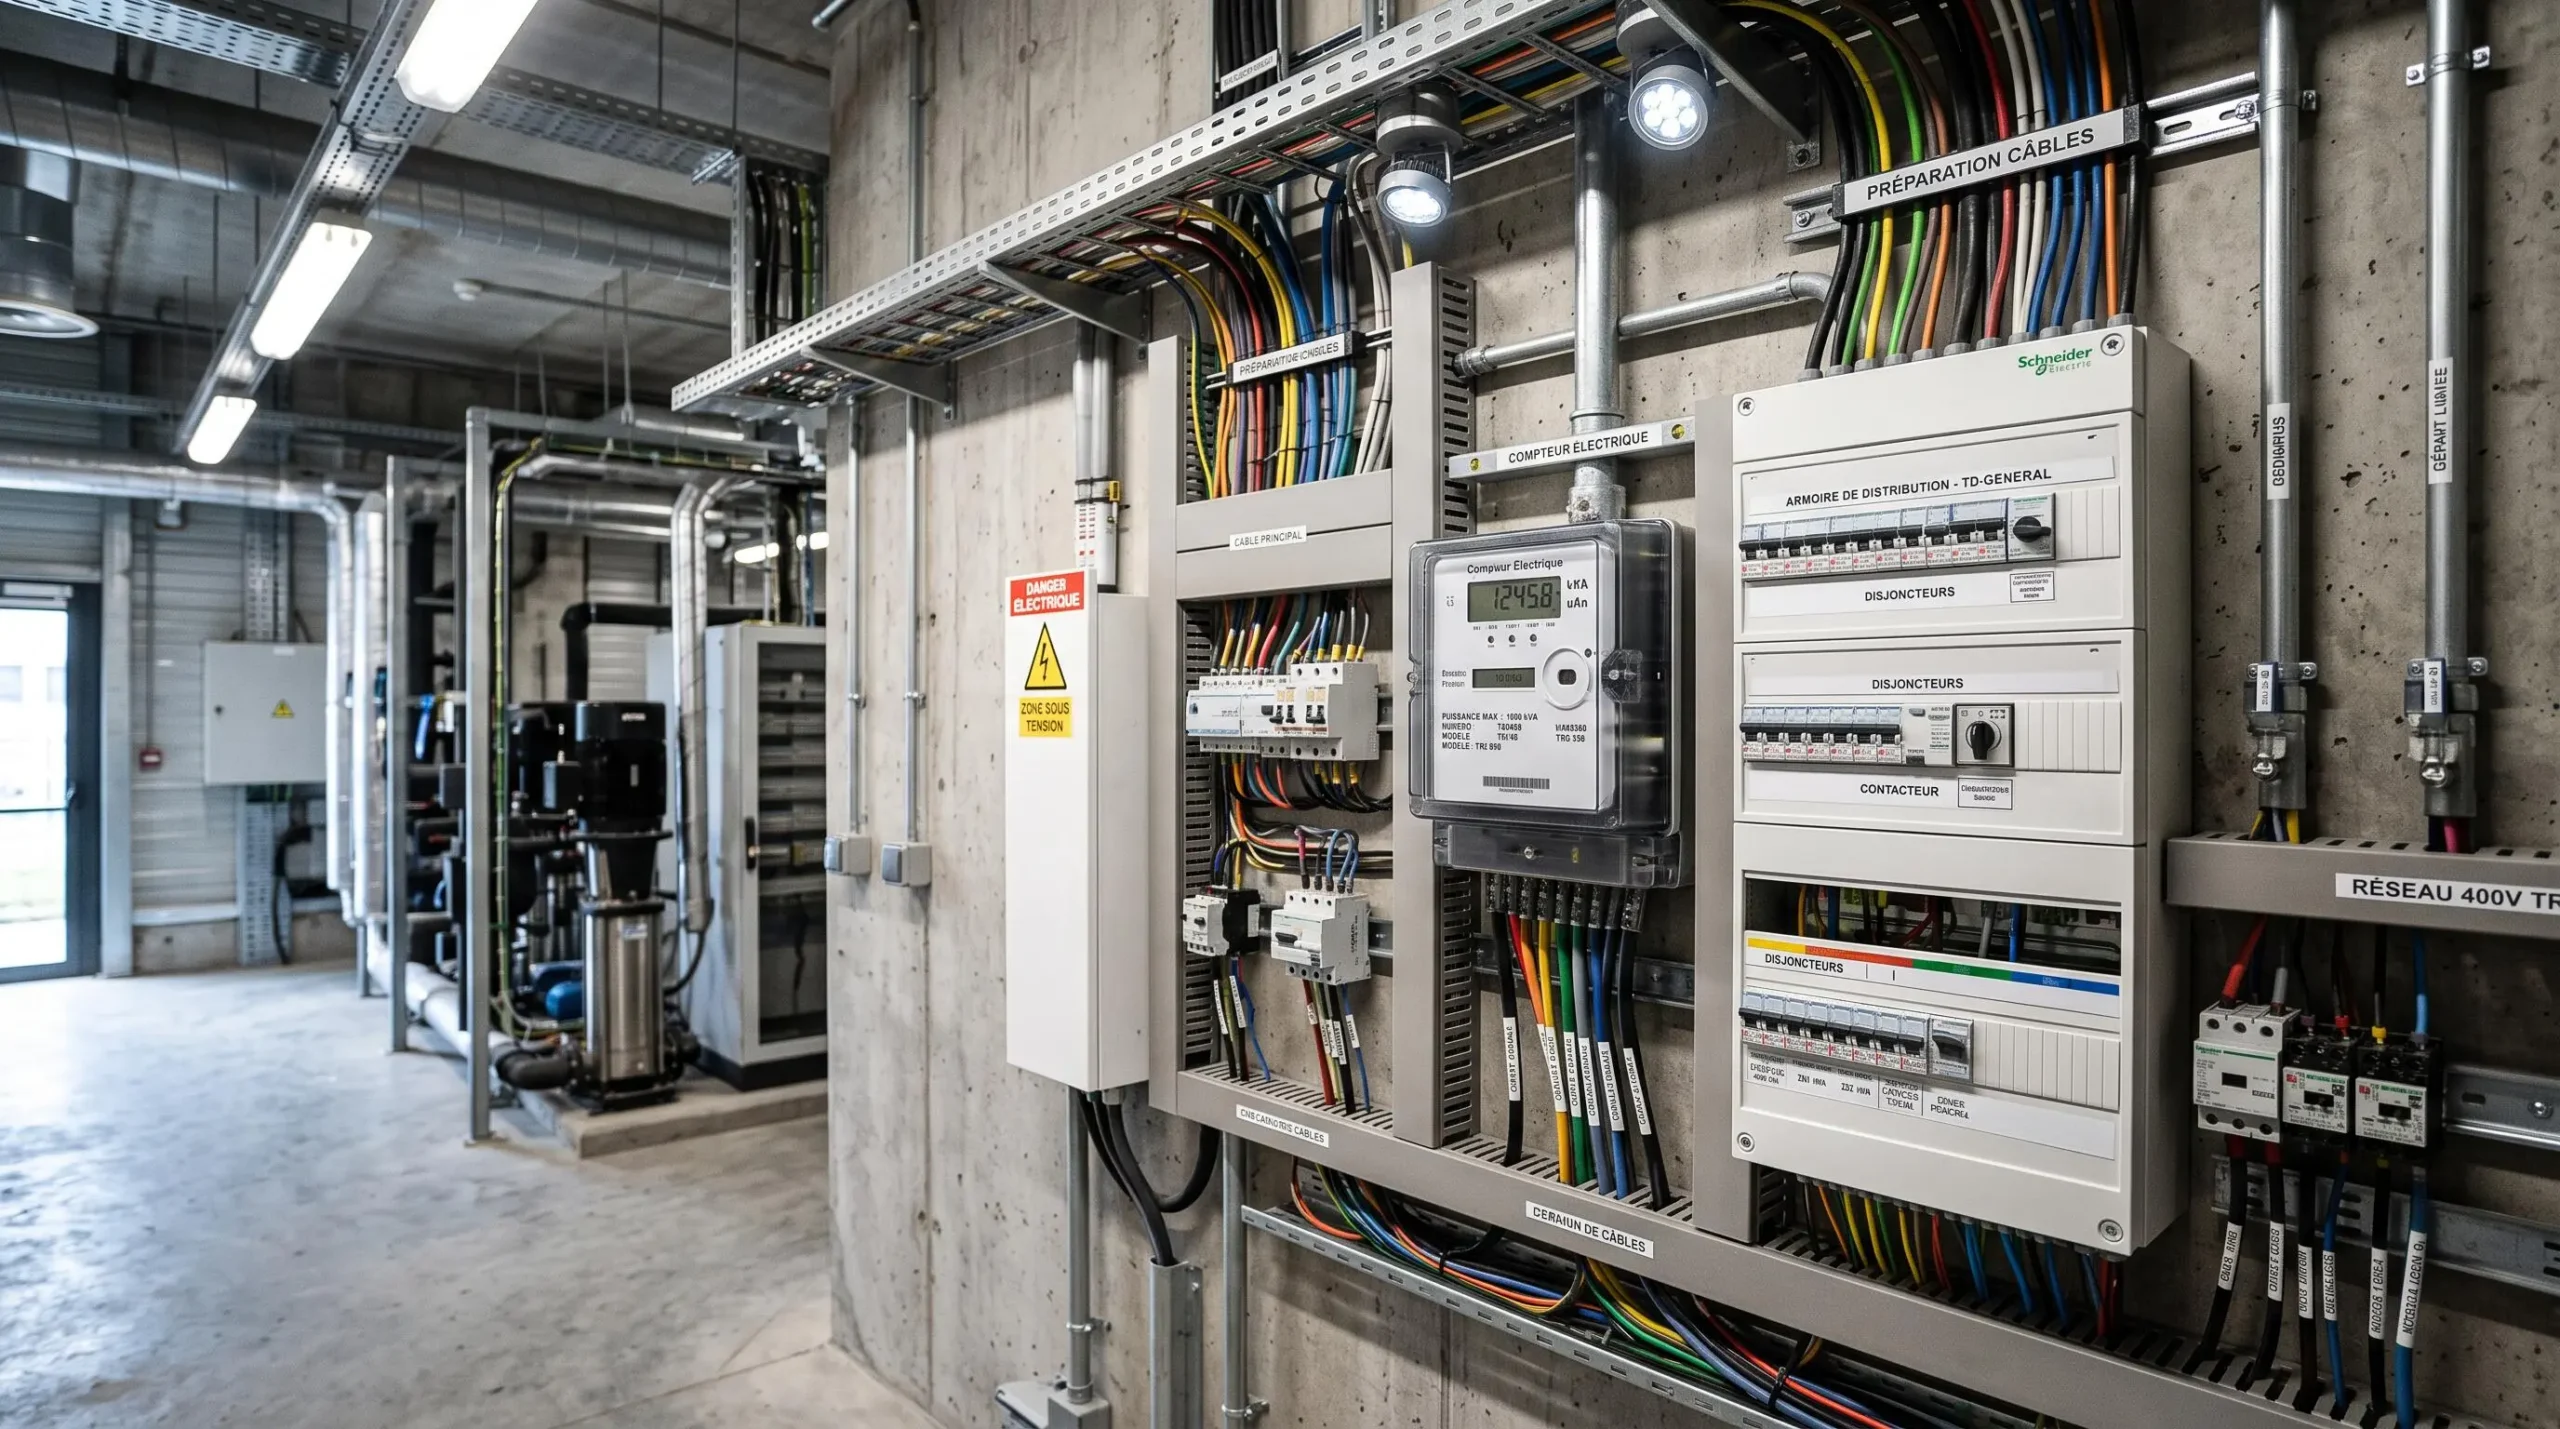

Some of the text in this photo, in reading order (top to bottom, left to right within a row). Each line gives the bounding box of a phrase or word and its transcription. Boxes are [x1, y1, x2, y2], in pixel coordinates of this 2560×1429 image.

[1867, 128, 2095, 200] PRÉPARATION CÂBLES
[2018, 348, 2093, 368] Schneider
[1508, 431, 1649, 464] COMPTEUR ÉLECTRIQUE
[1786, 491, 1839, 507] ARMOIRE
[1842, 489, 1859, 501] DE
[1862, 479, 1950, 500] DISTRIBUTION
[1962, 468, 2052, 489] TD-GENERAL
[1513, 559, 1564, 571] Electrique
[1026, 578, 1067, 596] DANGER
[1865, 586, 1956, 602] DISJONCTEURS
[1013, 592, 1081, 613] ÉLECTRIQUE
[1872, 678, 1964, 690] DISJONCTEURS
[1045, 702, 1070, 715] SOUS
[1441, 712, 1481, 721] PUISSANCE
[1482, 713, 1498, 721] MAX
[1026, 719, 1064, 733] TENSION
[1860, 783, 1940, 797] CONTACTEUR
[2353, 877, 2452, 901] RÉSEAU
[2461, 887, 2522, 907] 400V
[1765, 953, 1844, 974] DISJONCTEURS
[1294, 1126, 1325, 1143] CABLES
[1584, 1223, 1599, 1238] DE
